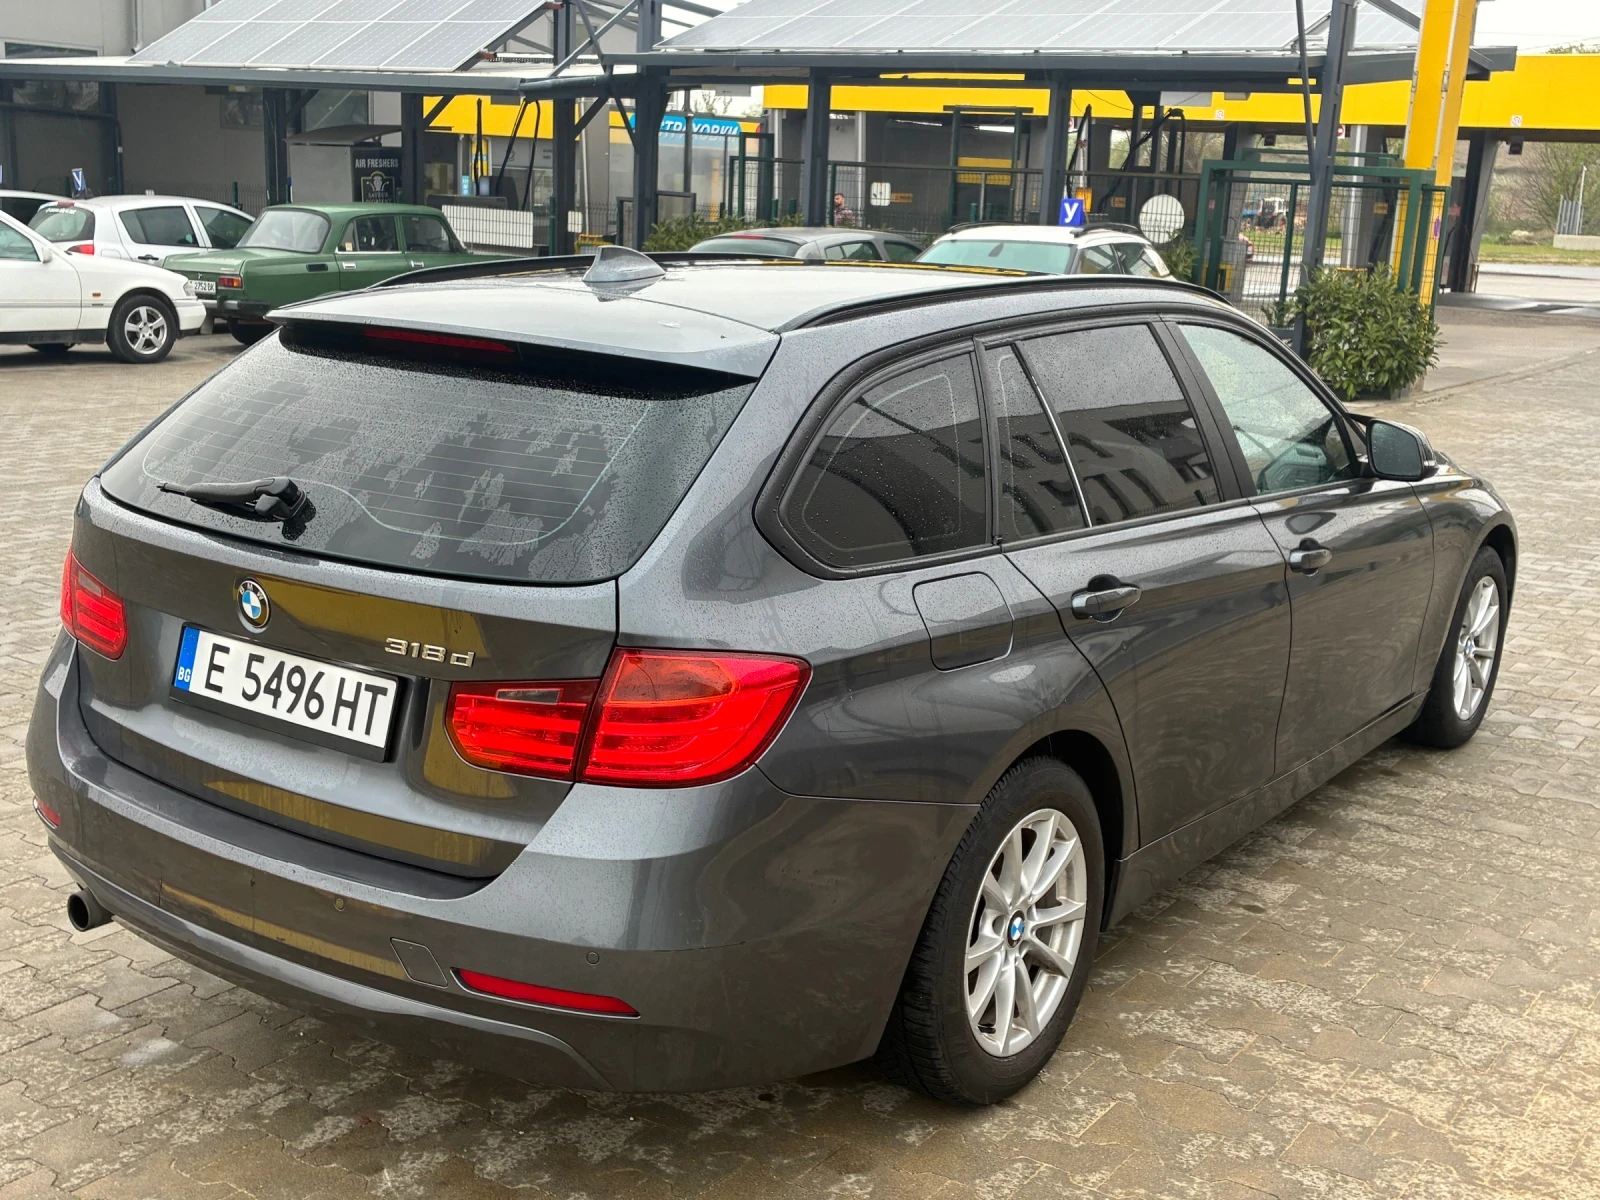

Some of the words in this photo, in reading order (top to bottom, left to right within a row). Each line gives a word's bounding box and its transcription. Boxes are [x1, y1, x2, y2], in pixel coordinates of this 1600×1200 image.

[355, 158, 366, 168] AIR
[367, 158, 399, 168] FRESHERS
[194, 281, 207, 291] 2752
[239, 582, 264, 600] BMW
[177, 666, 191, 683] BG
[204, 642, 231, 694] E
[241, 653, 326, 720] 5496
[331, 677, 389, 736] HT
